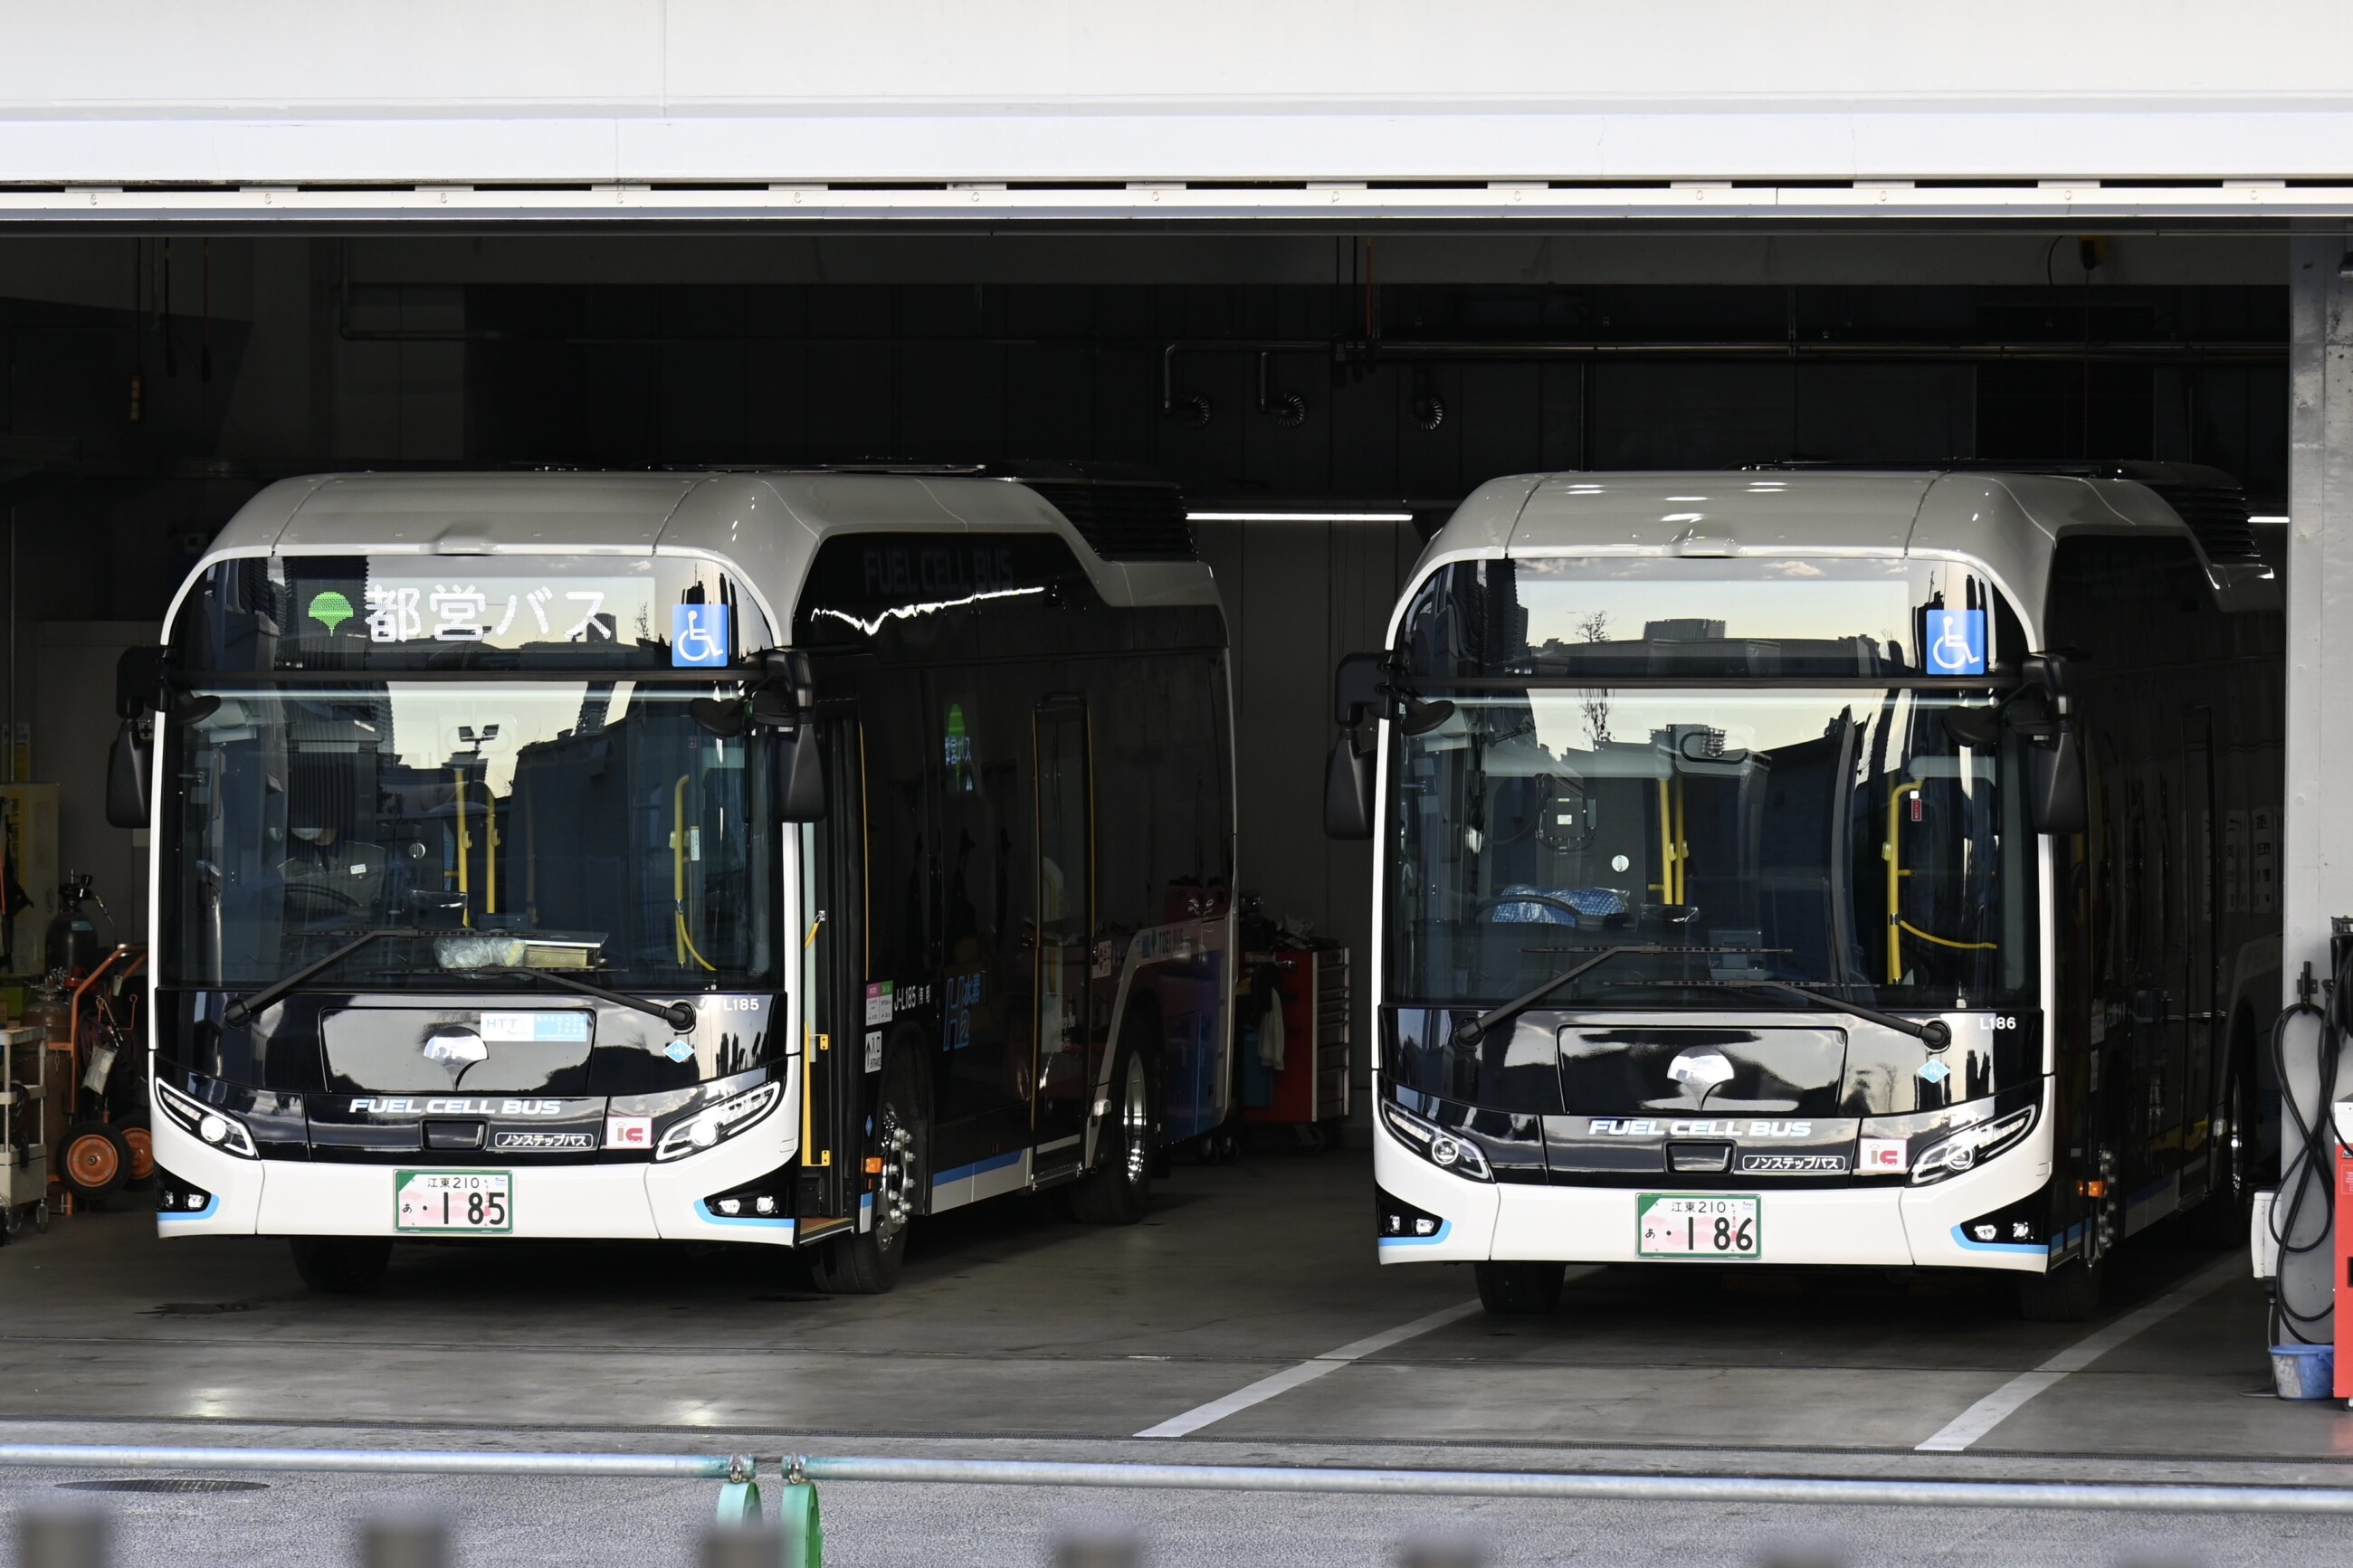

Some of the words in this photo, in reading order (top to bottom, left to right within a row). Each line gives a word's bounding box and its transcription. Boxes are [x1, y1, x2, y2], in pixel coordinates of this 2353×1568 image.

[863, 549, 918, 594] FUEL
[919, 549, 970, 593] CELL
[971, 548, 1013, 591] BUS
[365, 584, 611, 642] 都営バス
[963, 973, 981, 1007] 水素
[724, 998, 759, 1012] L185
[893, 985, 917, 1012] J-L185
[486, 1018, 518, 1029] HTT
[1979, 1016, 2016, 1031] L186
[348, 1098, 422, 1114] FUEL
[425, 1099, 497, 1115] CELL
[500, 1100, 562, 1116] BUS
[1588, 1119, 1665, 1136] FUEL
[1670, 1121, 1743, 1136] CELL
[1748, 1122, 1812, 1137] BUS
[501, 1134, 586, 1147] ノンステップバス
[1749, 1157, 1839, 1170] ノンステップバス
[402, 1202, 413, 1214] あ
[1644, 1228, 1655, 1240] あ
